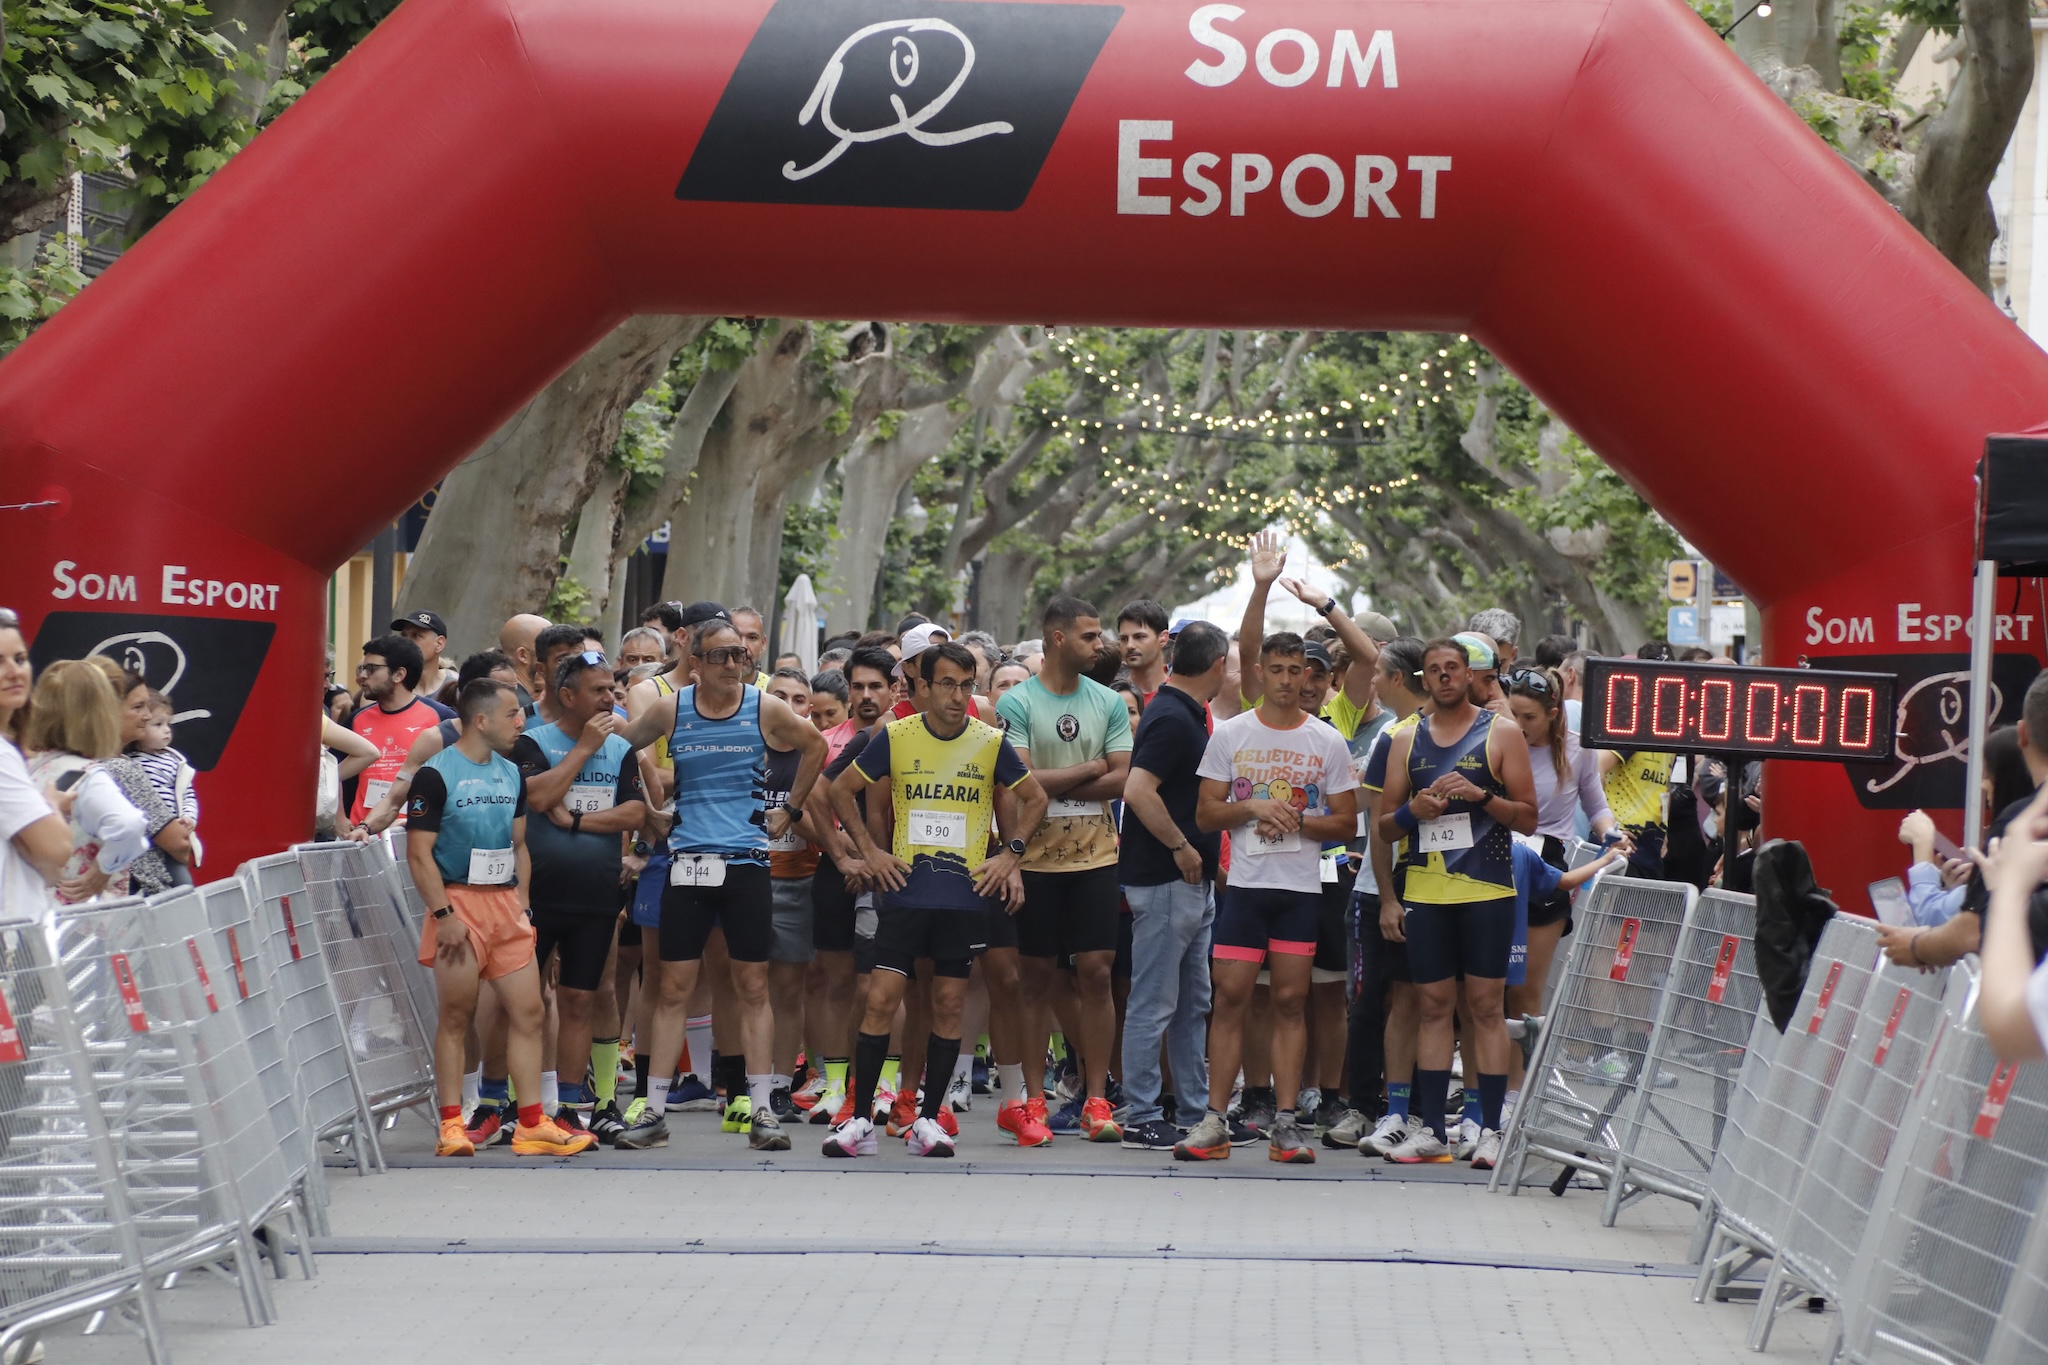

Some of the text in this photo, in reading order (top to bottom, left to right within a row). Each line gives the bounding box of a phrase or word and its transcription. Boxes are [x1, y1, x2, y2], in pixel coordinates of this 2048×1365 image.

[1184, 4, 1398, 88] SOM
[1117, 120, 1452, 219] ESPORT
[51, 560, 280, 611] SOM ESPORT
[1806, 606, 1875, 646] SOM
[1605, 673, 1874, 748] 00:00:00
[1233, 748, 1323, 769] BELIEVE IN
[574, 771, 619, 785] BLIDOM
[1236, 763, 1326, 786] YOURSELF
[586, 800, 599, 811] 63
[784, 833, 795, 843] 16
[925, 825, 949, 837] B 90
[1431, 829, 1454, 842] A 42
[488, 863, 505, 875] S 17
[686, 866, 709, 877] B 44
[1511, 945, 1527, 954] SME
